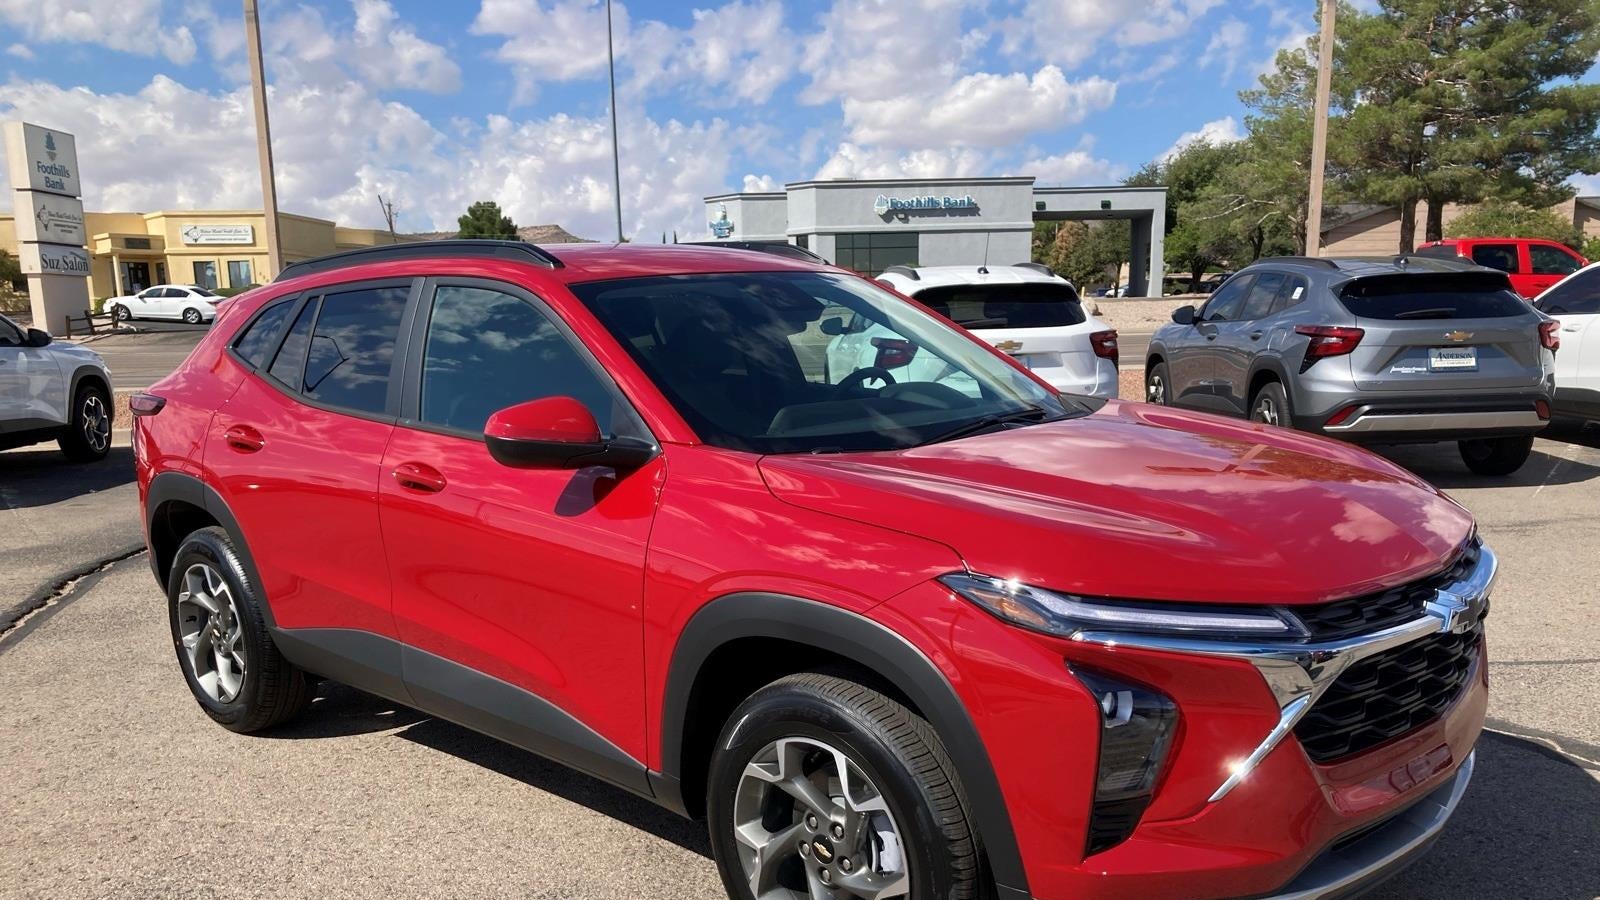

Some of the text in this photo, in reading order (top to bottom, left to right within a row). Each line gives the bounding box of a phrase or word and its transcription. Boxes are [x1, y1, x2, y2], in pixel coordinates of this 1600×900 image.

[37, 161, 70, 178] Foothills
[44, 176, 65, 190] Bank
[889, 195, 975, 209] Foothills Bank
[41, 253, 89, 271] Suz Salon
